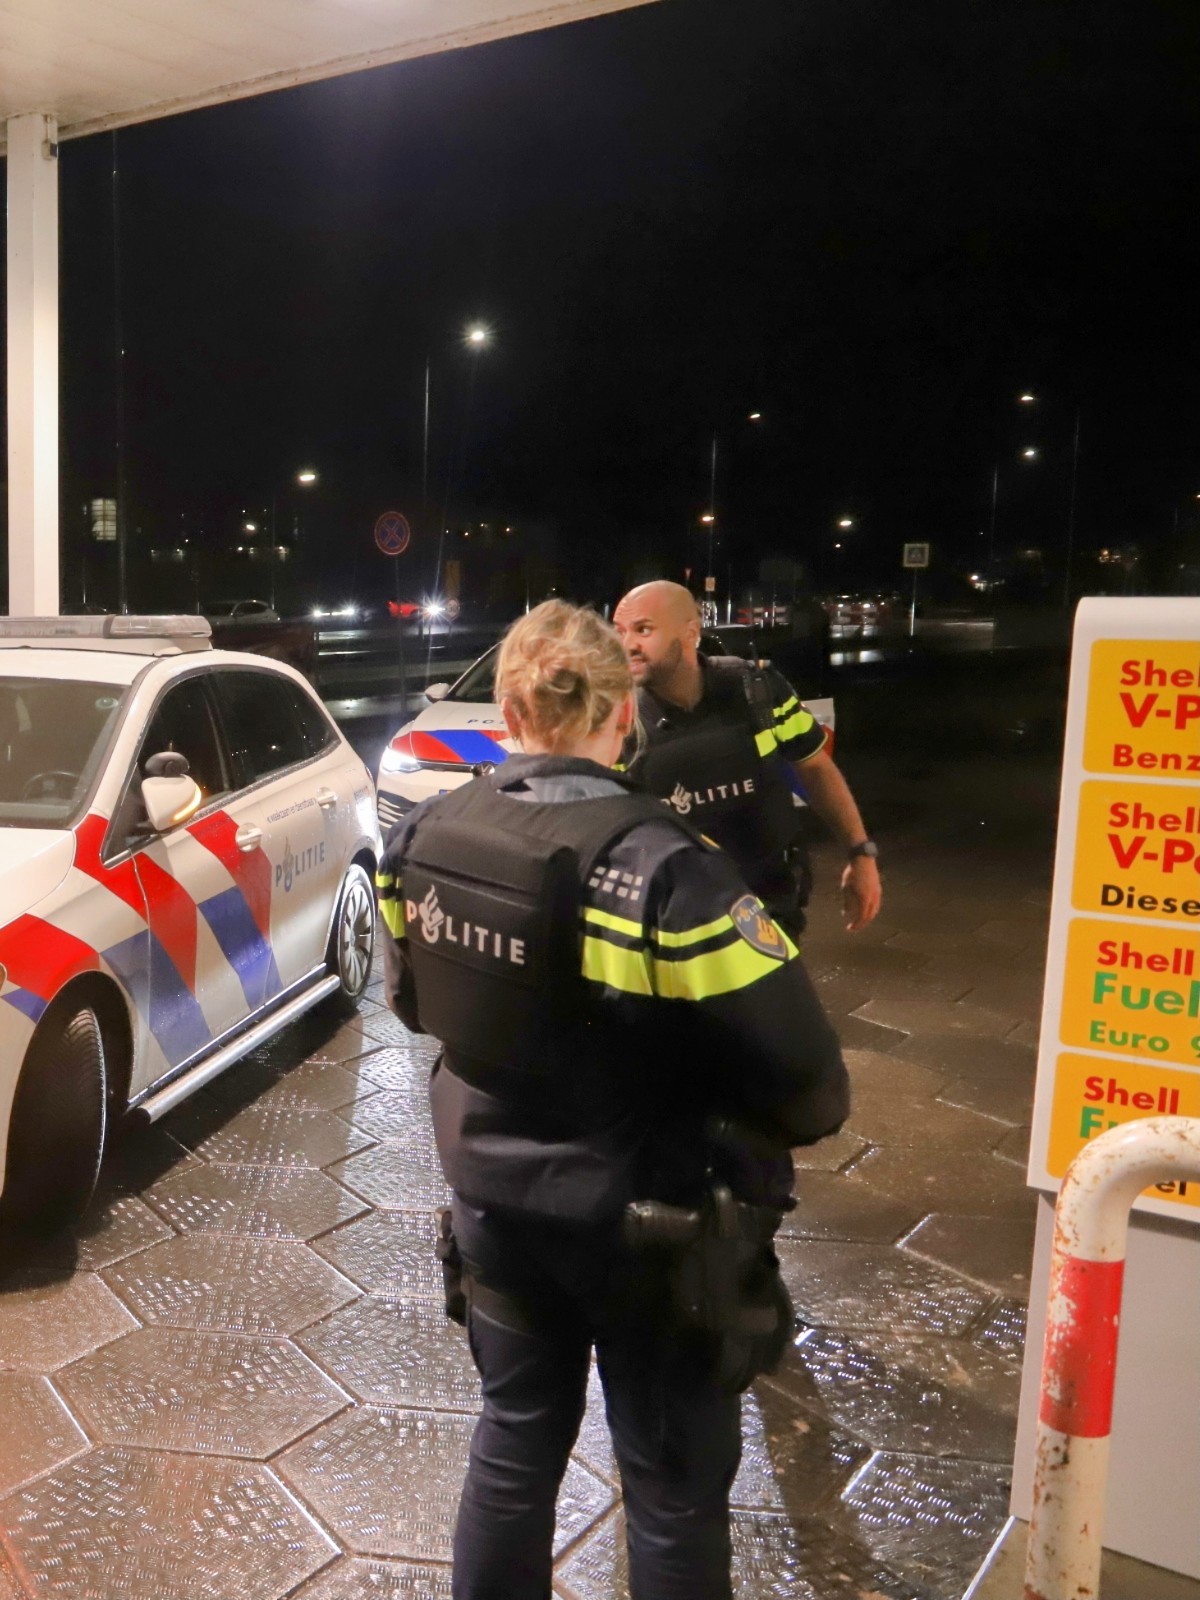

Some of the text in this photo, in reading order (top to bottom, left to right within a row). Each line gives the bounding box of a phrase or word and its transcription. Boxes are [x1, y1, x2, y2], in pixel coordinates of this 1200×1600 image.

[1120, 659, 1200, 688] She
[1120, 692, 1200, 730] V-P
[1113, 743, 1200, 771] Benz
[1108, 802, 1200, 834] Shel
[275, 837, 325, 892] POLITIE
[1107, 833, 1200, 874] V-P
[1101, 883, 1200, 917] Diese
[406, 884, 525, 965] POLITIE
[1097, 940, 1195, 976] Shell
[1093, 971, 1200, 1018] Fuel
[1089, 1020, 1170, 1053] Euro
[1083, 1076, 1180, 1115] Shell
[1080, 1106, 1119, 1139] F
